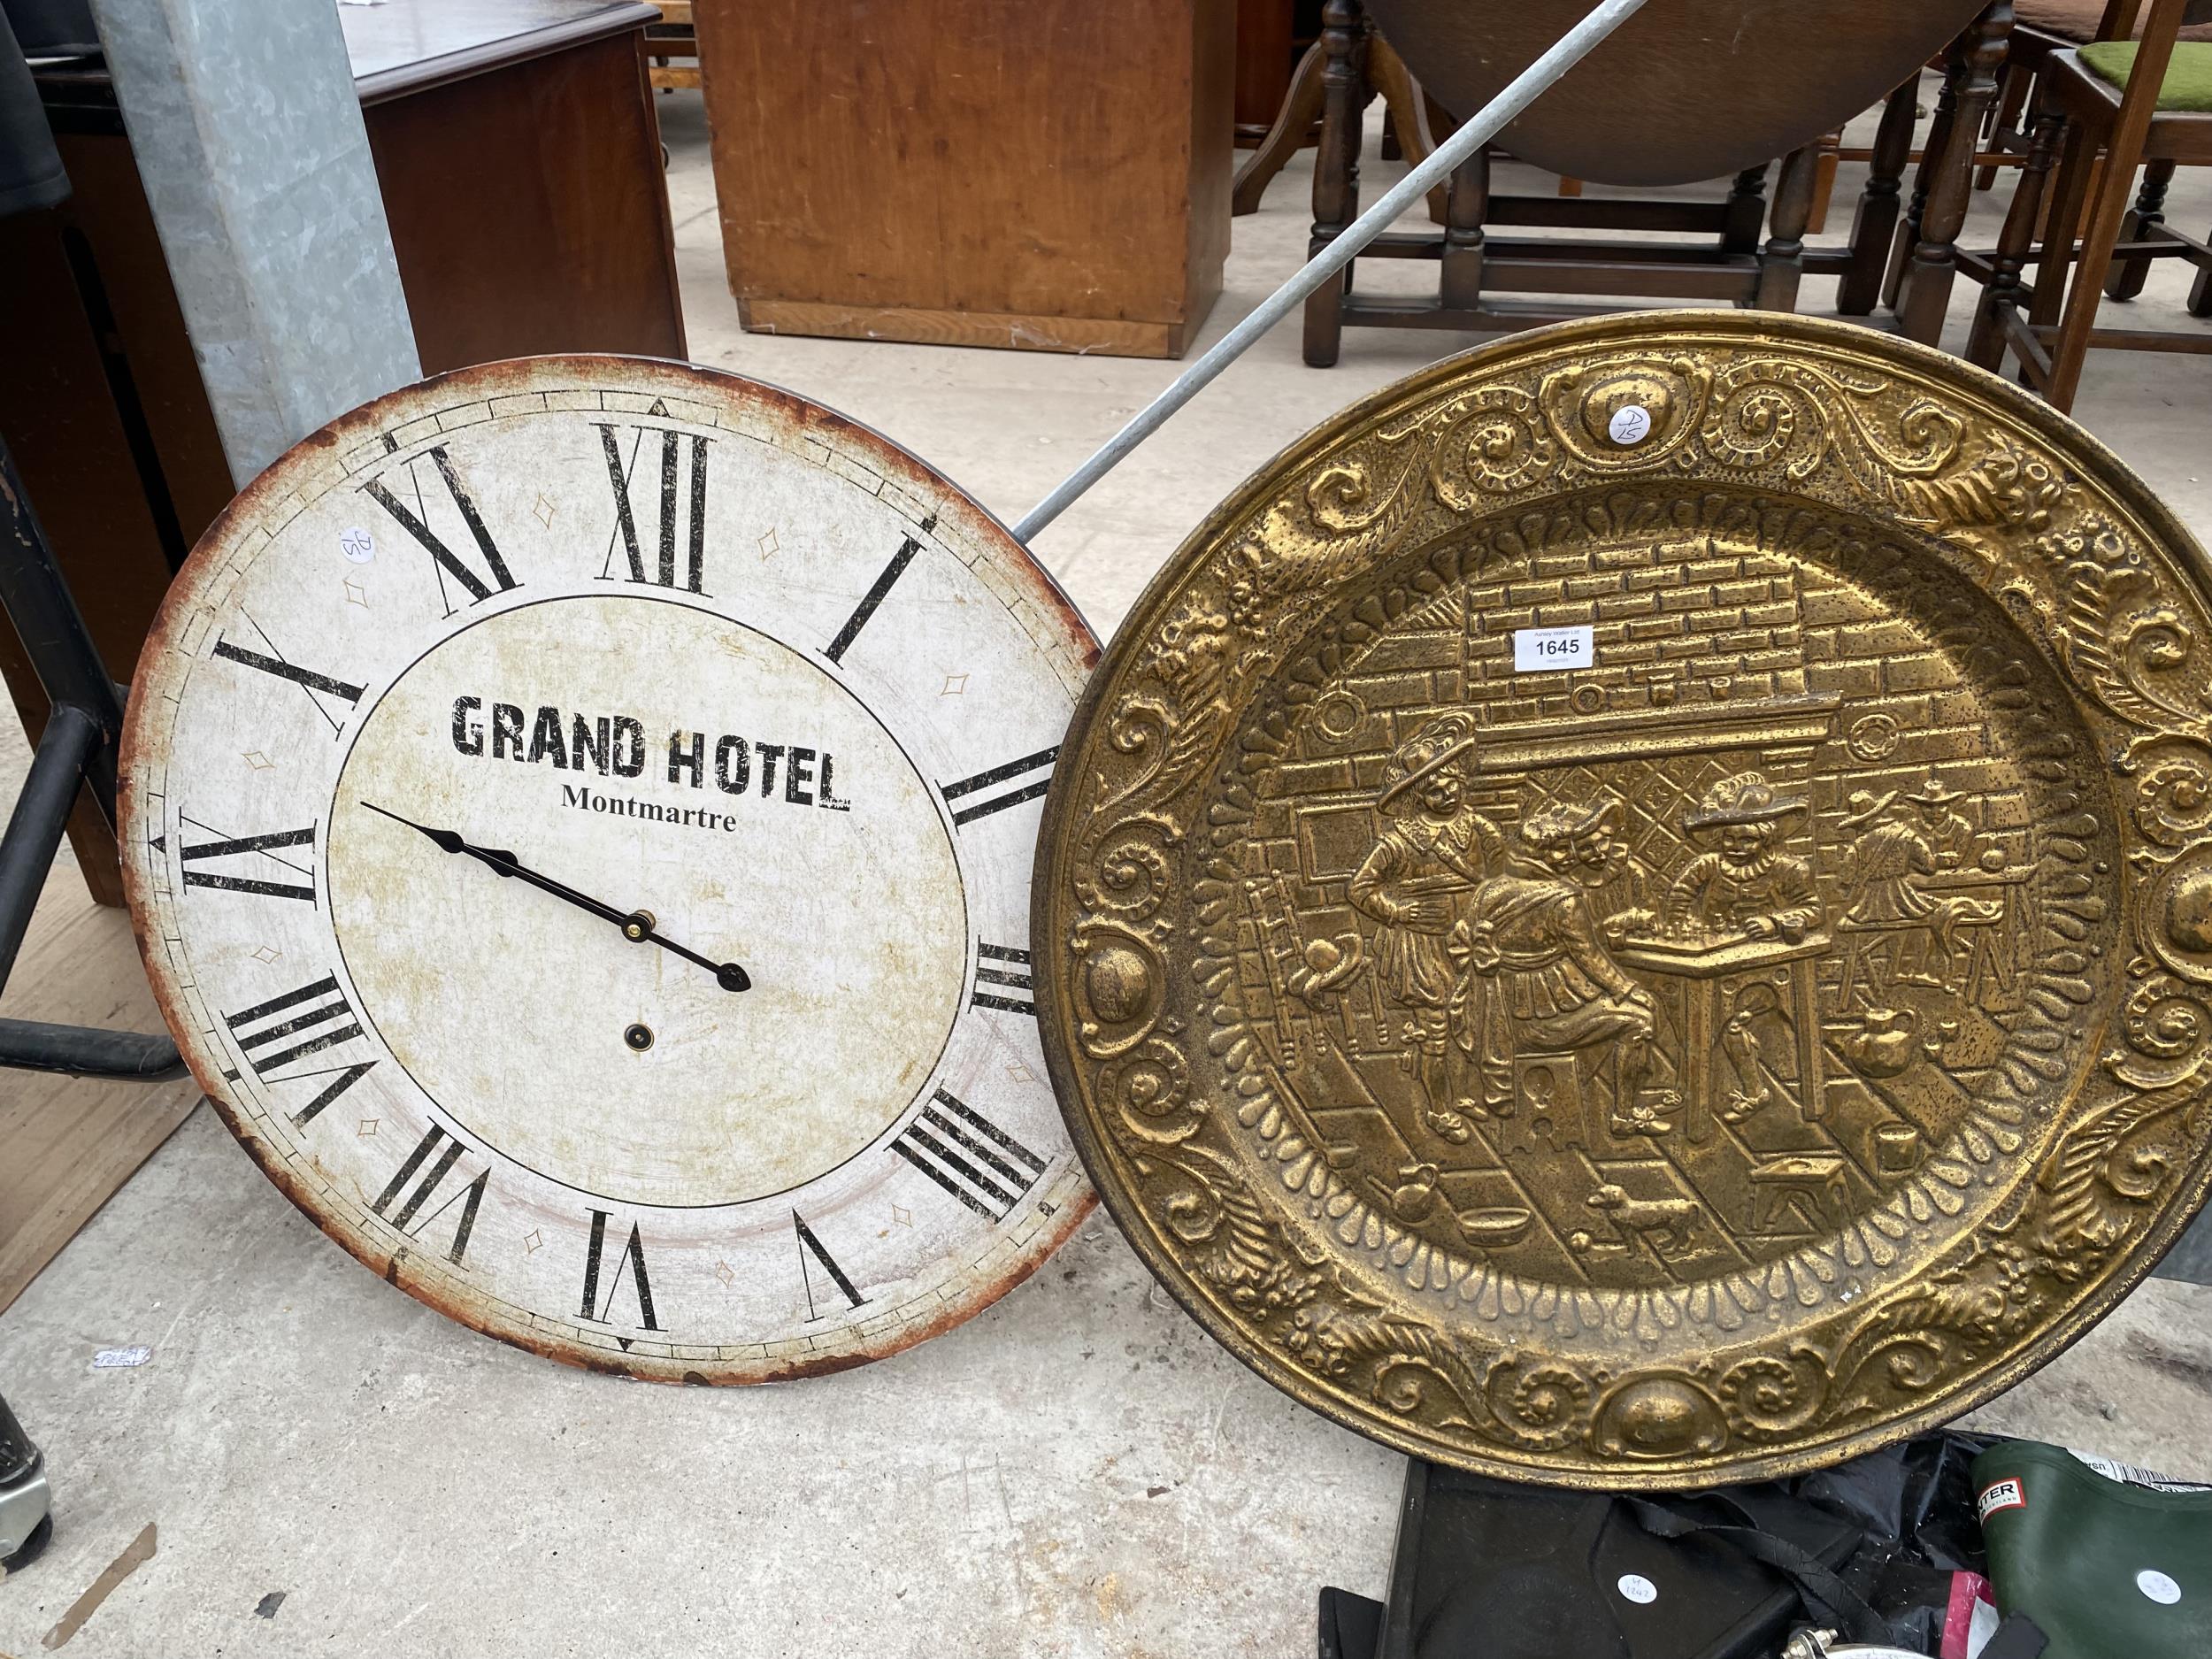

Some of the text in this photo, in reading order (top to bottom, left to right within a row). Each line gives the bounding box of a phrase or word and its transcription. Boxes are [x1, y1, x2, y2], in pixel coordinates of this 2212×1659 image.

[356, 441, 525, 620] XI
[588, 423, 718, 599] XII
[816, 531, 926, 670] I
[1536, 639, 1579, 656] 1645
[211, 604, 369, 741] X
[452, 695, 851, 812] GRAND HOTEL
[561, 784, 737, 833] Montmartre
[180, 805, 318, 910] IX
[219, 969, 380, 1138] VIII
[363, 1116, 491, 1271] VII
[885, 1079, 1055, 1223] IIII
[573, 1207, 669, 1332] VI
[792, 1207, 873, 1323] V
